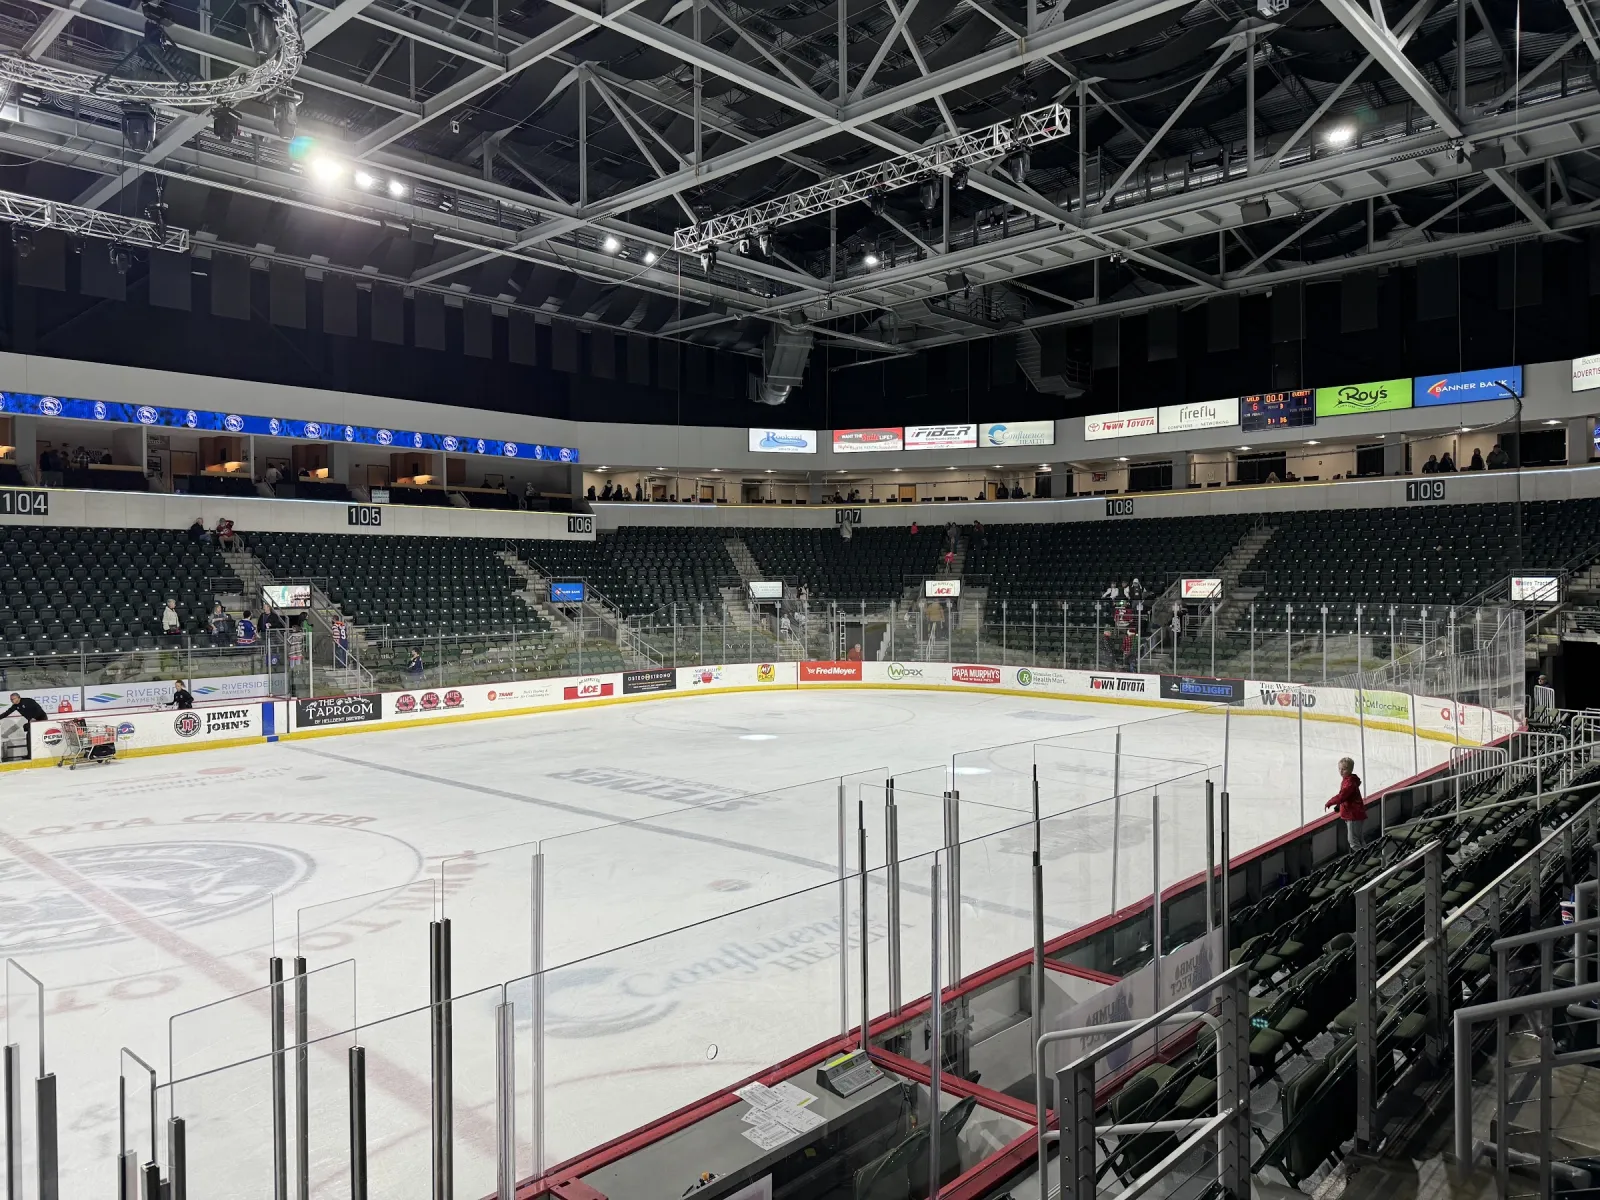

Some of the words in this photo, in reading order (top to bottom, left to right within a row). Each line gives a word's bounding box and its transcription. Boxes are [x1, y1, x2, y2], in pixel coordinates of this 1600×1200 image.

[1338, 385, 1388, 405] Roy's
[1436, 383, 1476, 393] BANNER
[1180, 406, 1216, 423] firefly
[1127, 417, 1154, 428] TOYOTA
[1002, 430, 1045, 440] Confluence
[1408, 482, 1444, 499] 109
[2, 493, 48, 513] 104
[1107, 500, 1133, 515] 108
[350, 507, 380, 524] 105
[837, 509, 860, 523] 107
[569, 517, 591, 532] 106
[952, 668, 968, 678] PAPA
[969, 669, 1000, 679] MURPHY'S
[221, 681, 269, 691] RIVERSIDE
[580, 685, 598, 694] ACE
[1116, 677, 1145, 692] TOYOTA
[1182, 683, 1202, 693] BUD
[1202, 685, 1231, 695] LIGHT
[126, 686, 175, 698] RIVERSI
[318, 698, 335, 707] THE
[206, 709, 249, 723] JIMMY
[306, 702, 373, 720] TAPROOM
[206, 720, 250, 734] JOHN'S
[182, 811, 379, 827] CENTER
[620, 910, 876, 999] Confluence
